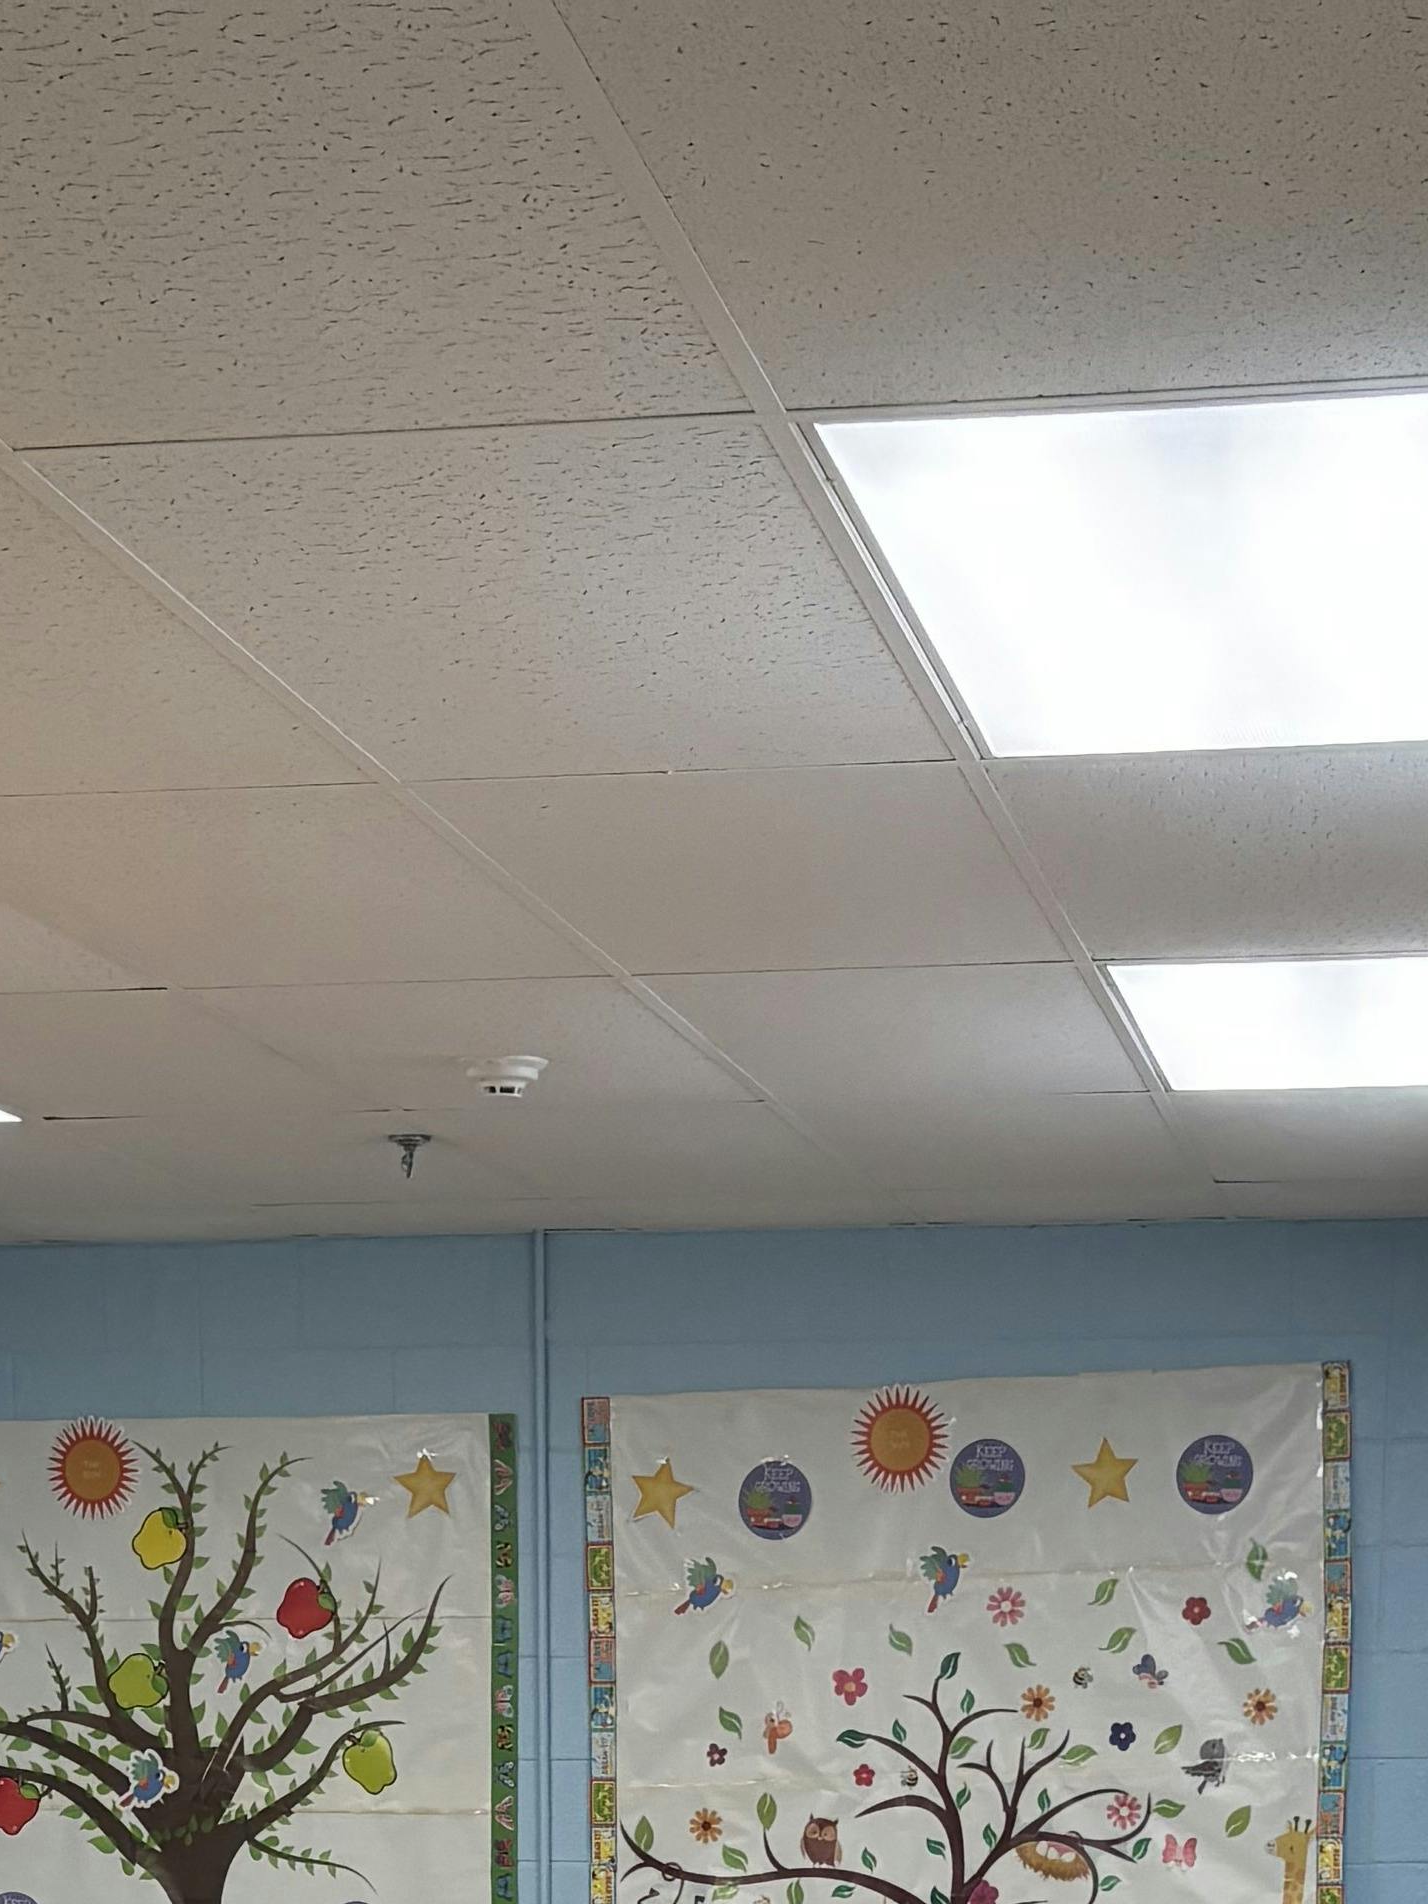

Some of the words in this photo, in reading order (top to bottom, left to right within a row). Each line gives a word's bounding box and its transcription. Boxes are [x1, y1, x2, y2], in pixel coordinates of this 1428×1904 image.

[976, 1443, 1006, 1458] KEEP
[1204, 1440, 1234, 1455] KEEP
[763, 1463, 793, 1481] KEEP
